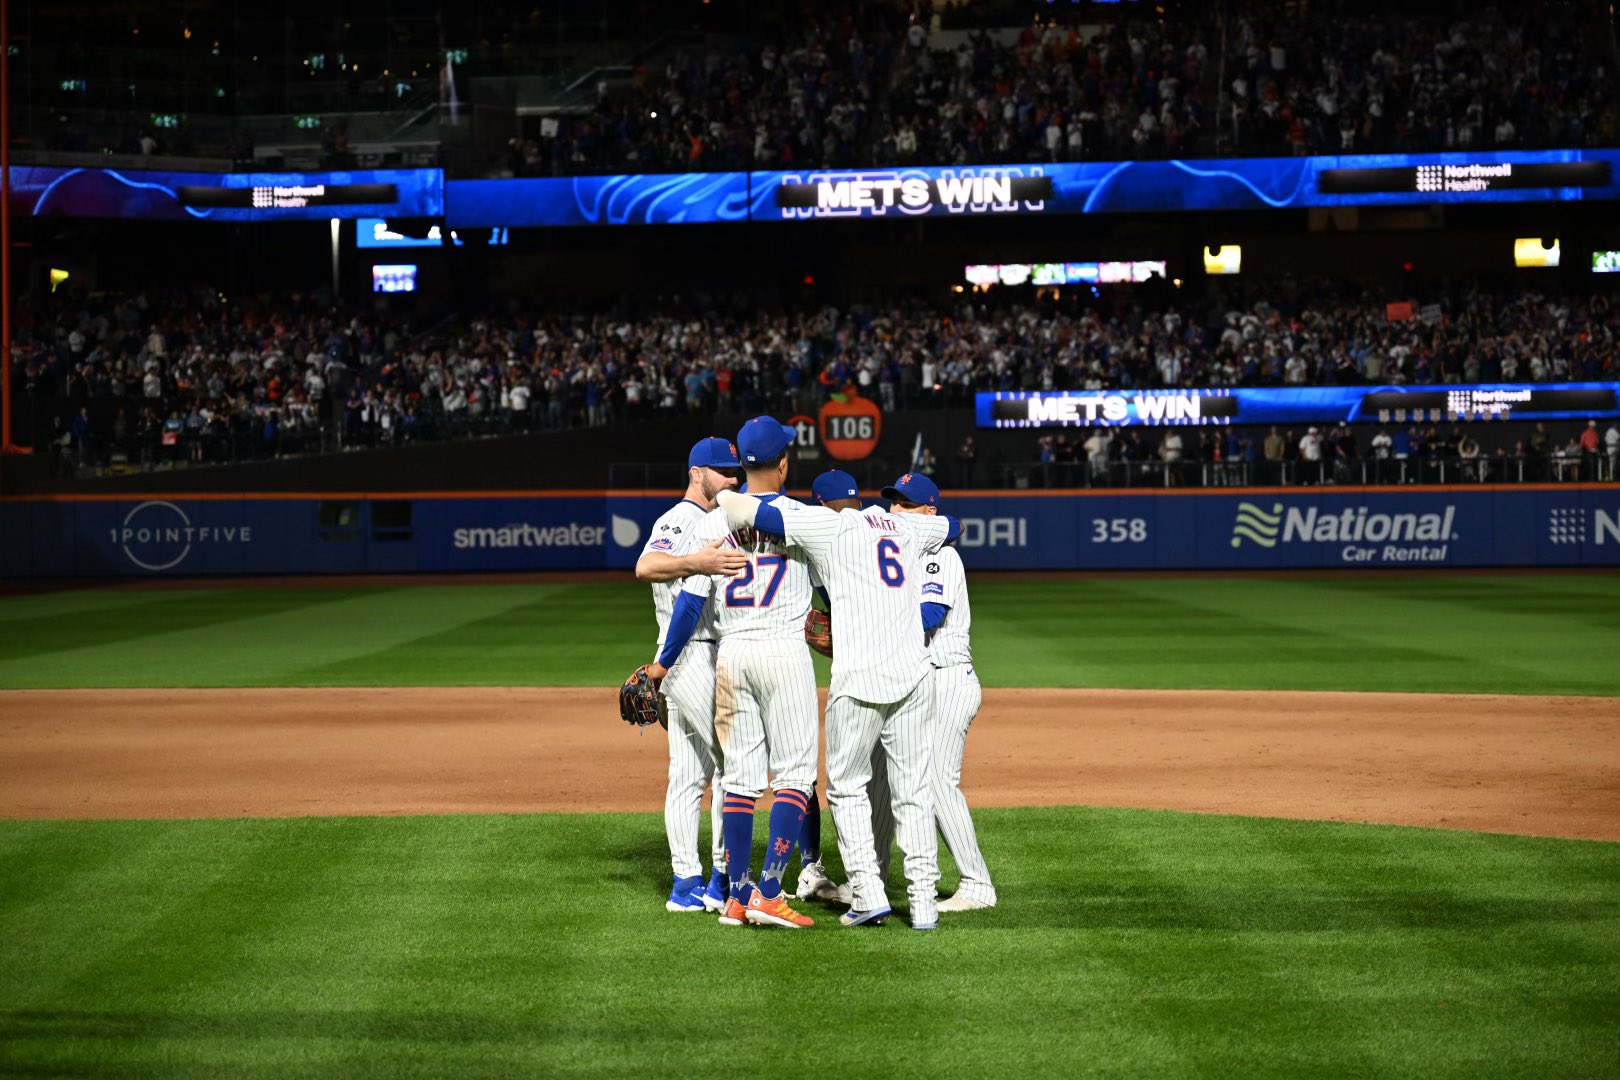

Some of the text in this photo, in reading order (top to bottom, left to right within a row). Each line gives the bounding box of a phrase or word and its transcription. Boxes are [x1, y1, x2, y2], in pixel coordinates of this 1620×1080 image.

[1444, 163, 1511, 178] Northwell
[817, 176, 1011, 207] METS WIN
[1444, 178, 1487, 191] Health
[1028, 394, 1200, 421] METS WIN
[831, 417, 872, 439] 106
[110, 527, 251, 543] 1POINTFIVE
[453, 522, 605, 547] smartwater
[864, 514, 900, 533] MARTE
[1092, 518, 1147, 543] 358
[1282, 505, 1455, 542] National
[877, 537, 905, 588] 6
[1342, 545, 1447, 561] Car Rental
[928, 564, 938, 573] 24
[725, 554, 788, 608] 27
